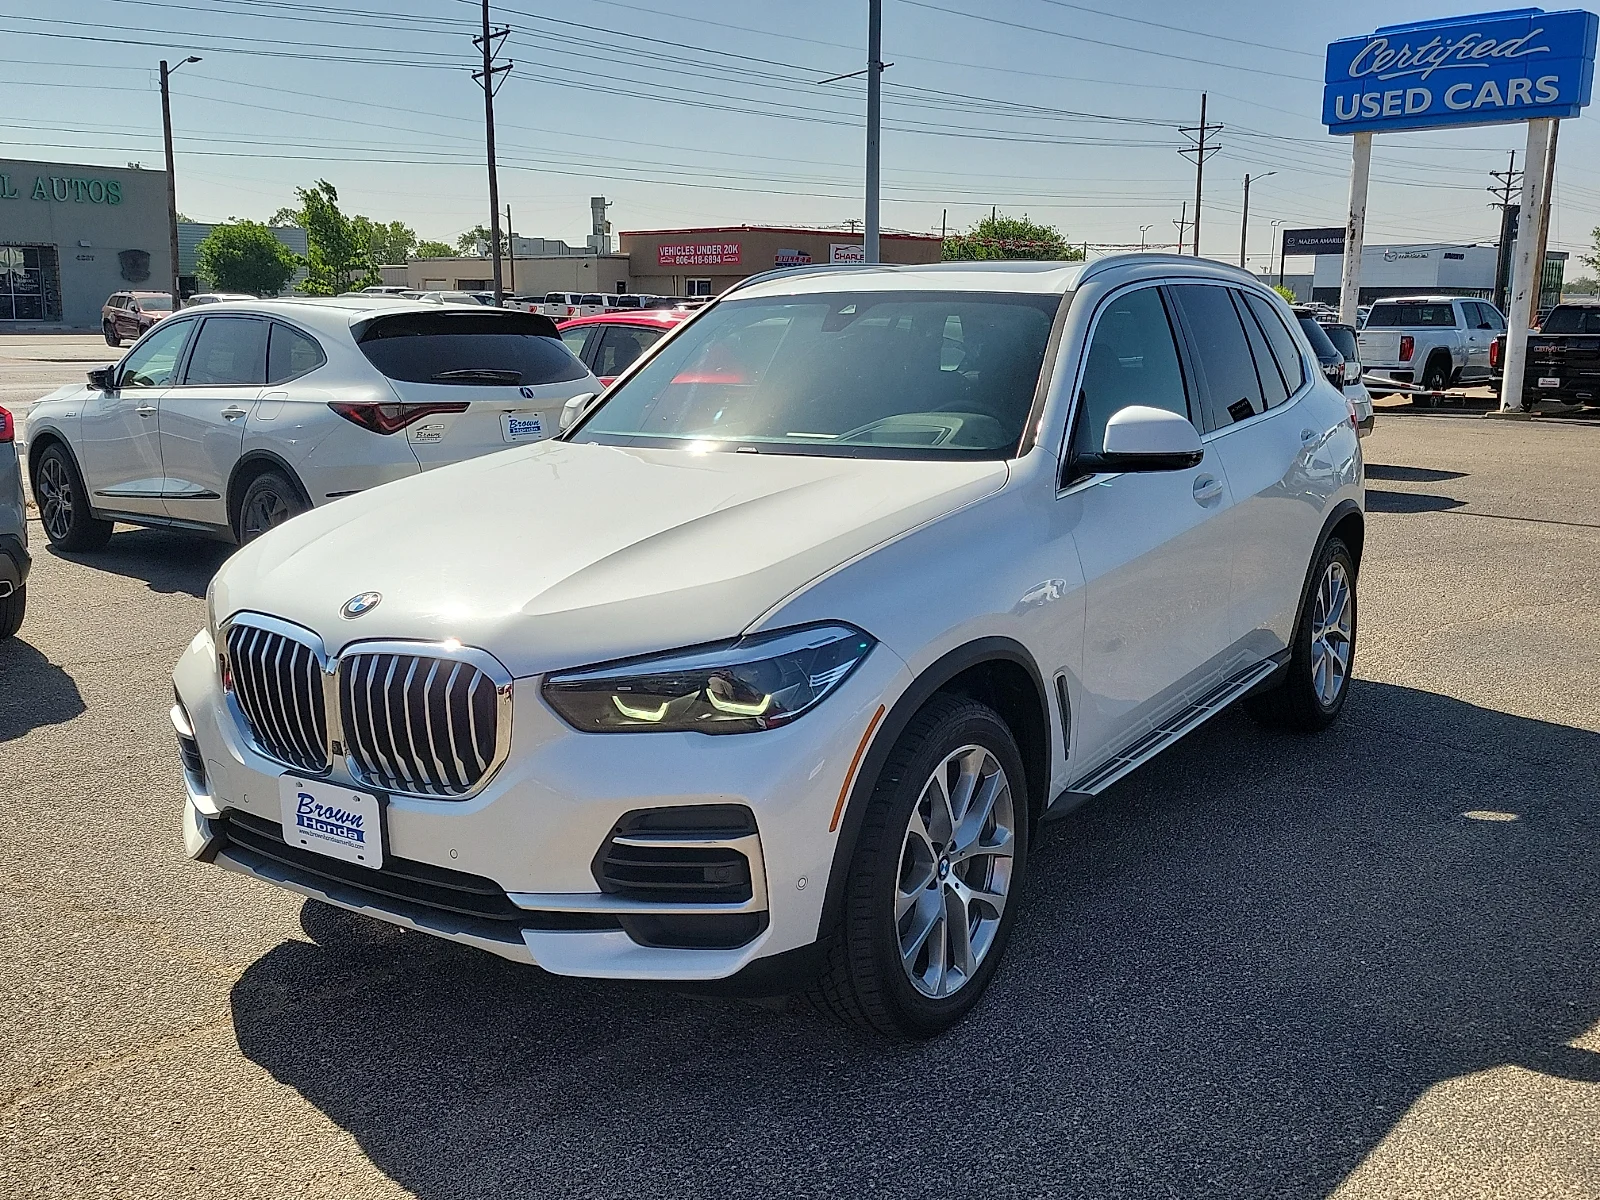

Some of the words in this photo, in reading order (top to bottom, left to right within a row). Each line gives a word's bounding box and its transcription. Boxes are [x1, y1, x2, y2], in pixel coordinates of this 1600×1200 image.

[1348, 28, 1550, 81] Certified
[1335, 87, 1433, 121] USED
[1443, 76, 1560, 110] CARS
[0, 174, 19, 199] L
[31, 176, 122, 205] AUTOS
[660, 245, 695, 256] VEHICLES
[696, 244, 722, 255] UNDER
[723, 244, 739, 254] 20K
[675, 255, 721, 265] 806-418-6894
[834, 252, 865, 261] CHARLE
[508, 419, 540, 429] Brown
[296, 792, 364, 828] Brown
[303, 816, 358, 840] Honda
